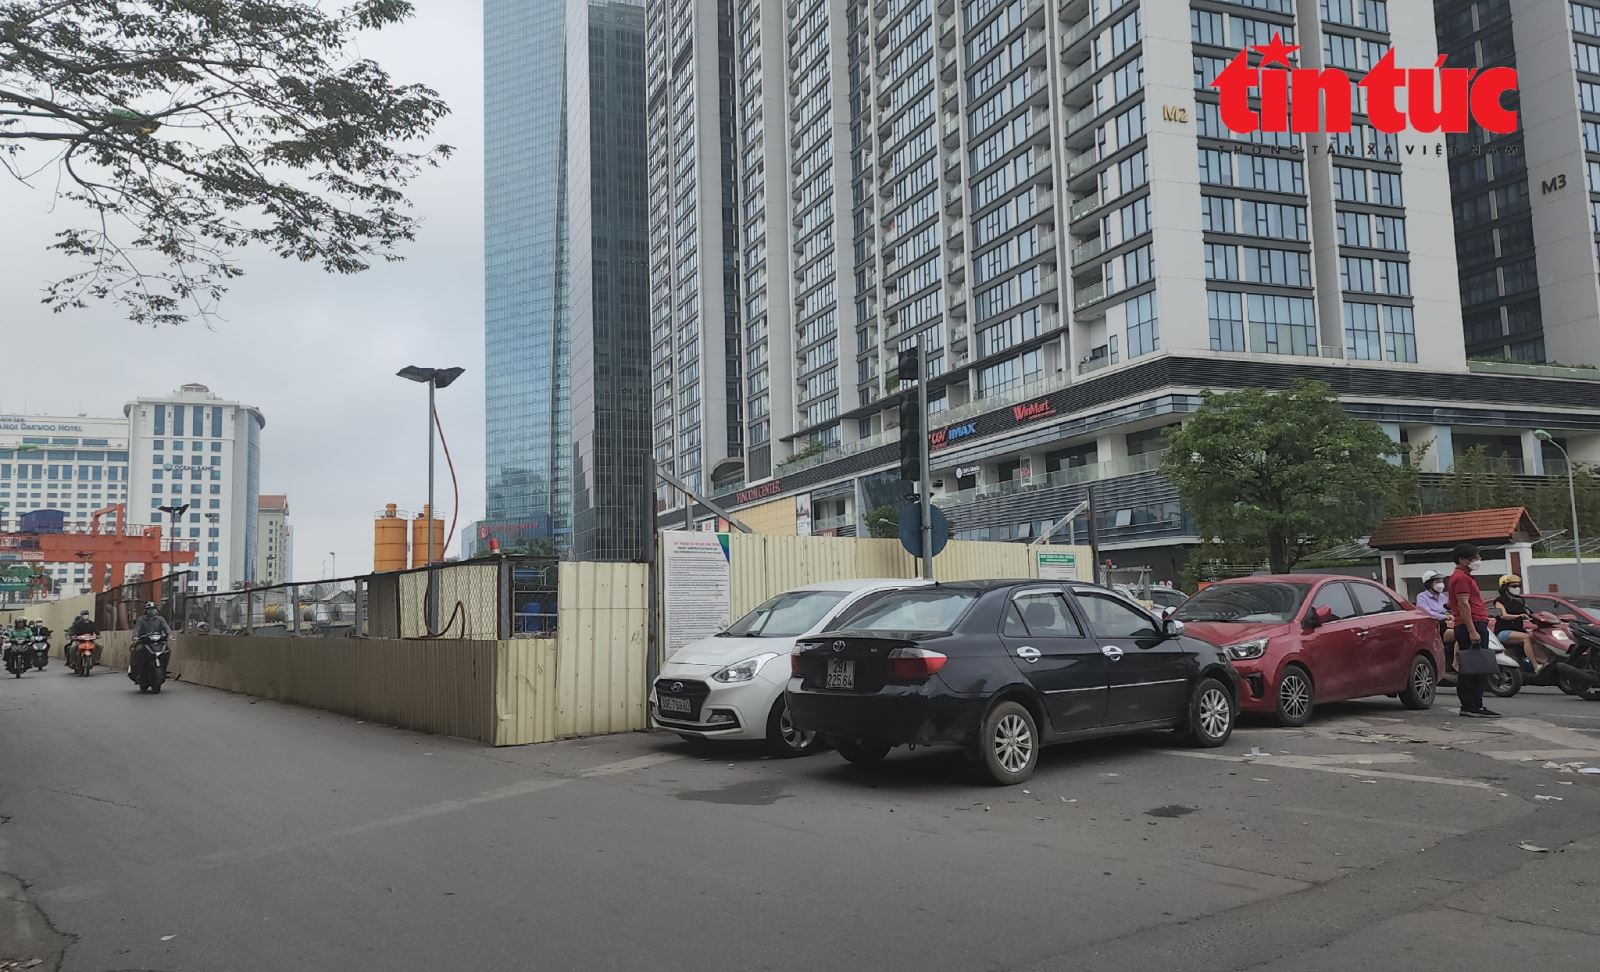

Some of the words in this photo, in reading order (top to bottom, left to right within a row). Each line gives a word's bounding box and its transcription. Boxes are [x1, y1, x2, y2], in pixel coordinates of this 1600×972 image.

[1163, 104, 1188, 123] M2
[1541, 174, 1567, 195] M3
[1013, 399, 1050, 421] WinMart
[58, 424, 83, 432] HOTEL
[949, 422, 976, 440] IMAX
